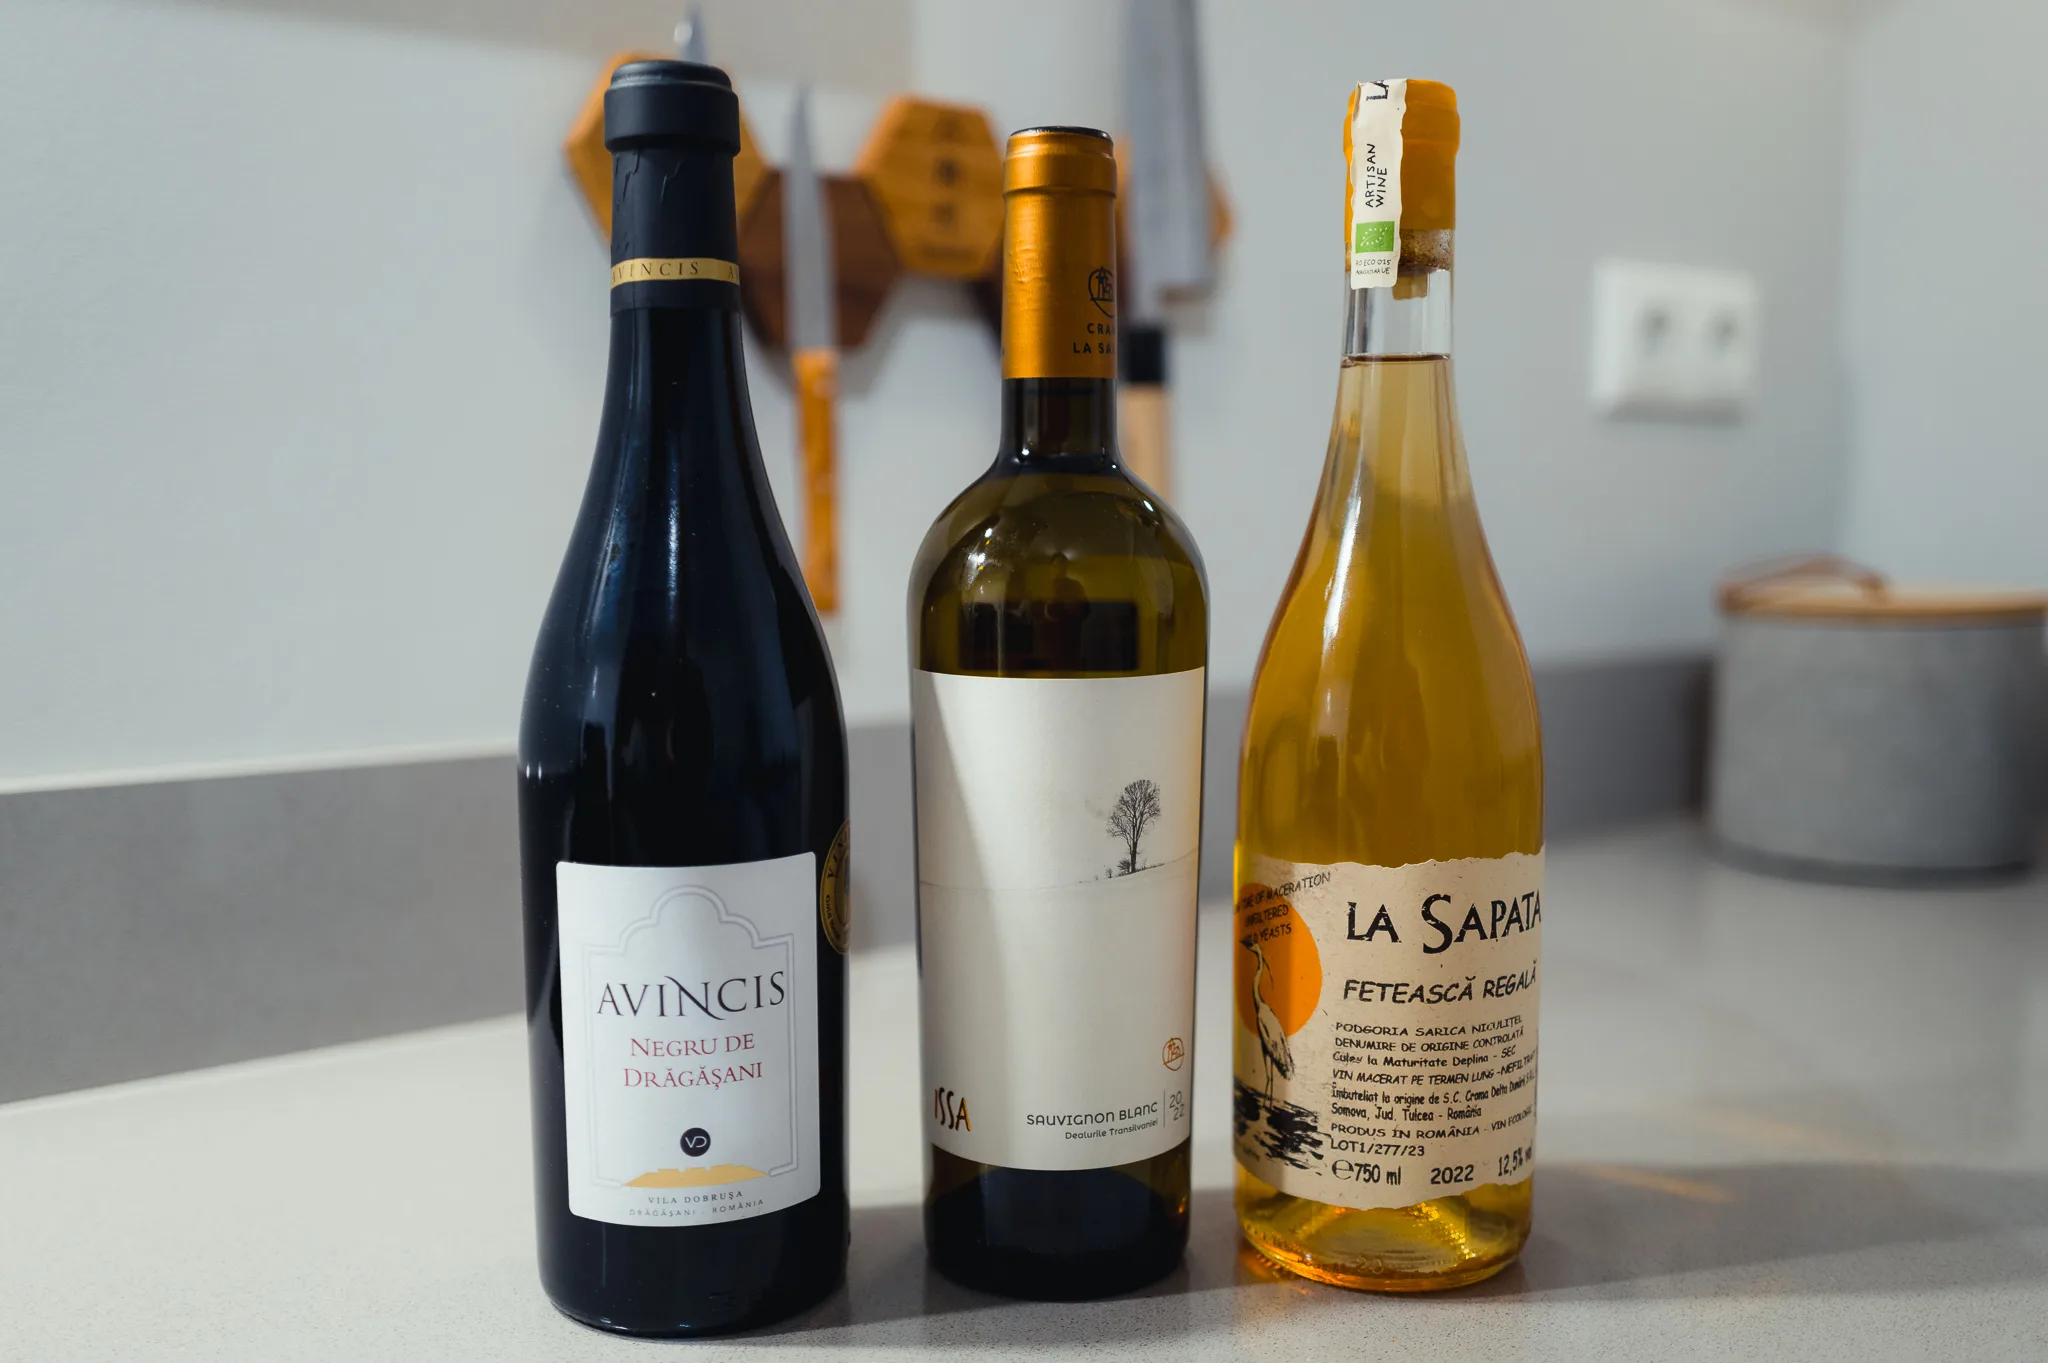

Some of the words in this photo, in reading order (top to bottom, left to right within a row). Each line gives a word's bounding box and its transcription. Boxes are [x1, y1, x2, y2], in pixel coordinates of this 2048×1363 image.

[1365, 143, 1376, 208] ARTISAN
[1375, 167, 1387, 208] WINE
[611, 261, 698, 284] AVINCIS
[1087, 322, 1115, 335] CRA
[1073, 342, 1092, 354] LA
[1098, 342, 1115, 354] SA
[1266, 871, 1331, 900] MACERATION
[1346, 901, 1400, 943] LA
[1421, 887, 1542, 954] SAPATA
[1343, 975, 1476, 1004] FETEASCĂ
[1482, 959, 1537, 999] REGALĂ
[597, 971, 785, 1021] AVINCIS
[1335, 1021, 1408, 1036] PODGORIA
[1415, 1026, 1466, 1037] SARICA
[629, 1037, 717, 1057] NEGRU
[725, 1033, 755, 1053] DE
[1335, 1037, 1396, 1051] DENUMIRE
[1401, 1042, 1416, 1052] DE
[1420, 1040, 1469, 1052] ORIGINE
[1367, 1055, 1378, 1066] la
[1383, 1056, 1448, 1067] Maturitate
[1452, 1054, 1489, 1067] Deplina
[1500, 1044, 1517, 1059] SEC
[1332, 1068, 1353, 1081] VIN
[1356, 1072, 1408, 1085] MACERAT
[1411, 1074, 1424, 1085] PE
[1428, 1073, 1469, 1086] TERMEN
[1471, 1069, 1495, 1083] LUNG
[934, 1086, 972, 1132] ISSA
[1169, 1090, 1183, 1109] 20
[1381, 1090, 1391, 1104] la
[1393, 1092, 1425, 1109] origine
[1428, 1091, 1440, 1105] de
[1442, 1090, 1462, 1105] S.C.
[1465, 1089, 1489, 1103] Crama
[1026, 1110, 1115, 1127] SAUVIGNON
[1118, 1101, 1158, 1121] BLANC
[1172, 1104, 1186, 1121] 22
[1331, 1102, 1370, 1121] Somova,
[1374, 1106, 1397, 1121] Jud.
[1401, 1107, 1434, 1122] Tulcea
[1447, 1104, 1482, 1120] România
[1065, 1128, 1107, 1140] Dealurile
[1109, 1118, 1159, 1137] Transilvaniei
[1331, 1122, 1387, 1137] PRODUS
[1416, 1125, 1480, 1139] ROMÂNIA
[1491, 1119, 1507, 1132] VIN
[1330, 1139, 1425, 1156] LOT1/277/23
[1386, 1165, 1401, 1186] ml
[1430, 1164, 1475, 1185] 2022
[1497, 1146, 1524, 1177] 12,5%
[648, 1196, 678, 1204] VILA
